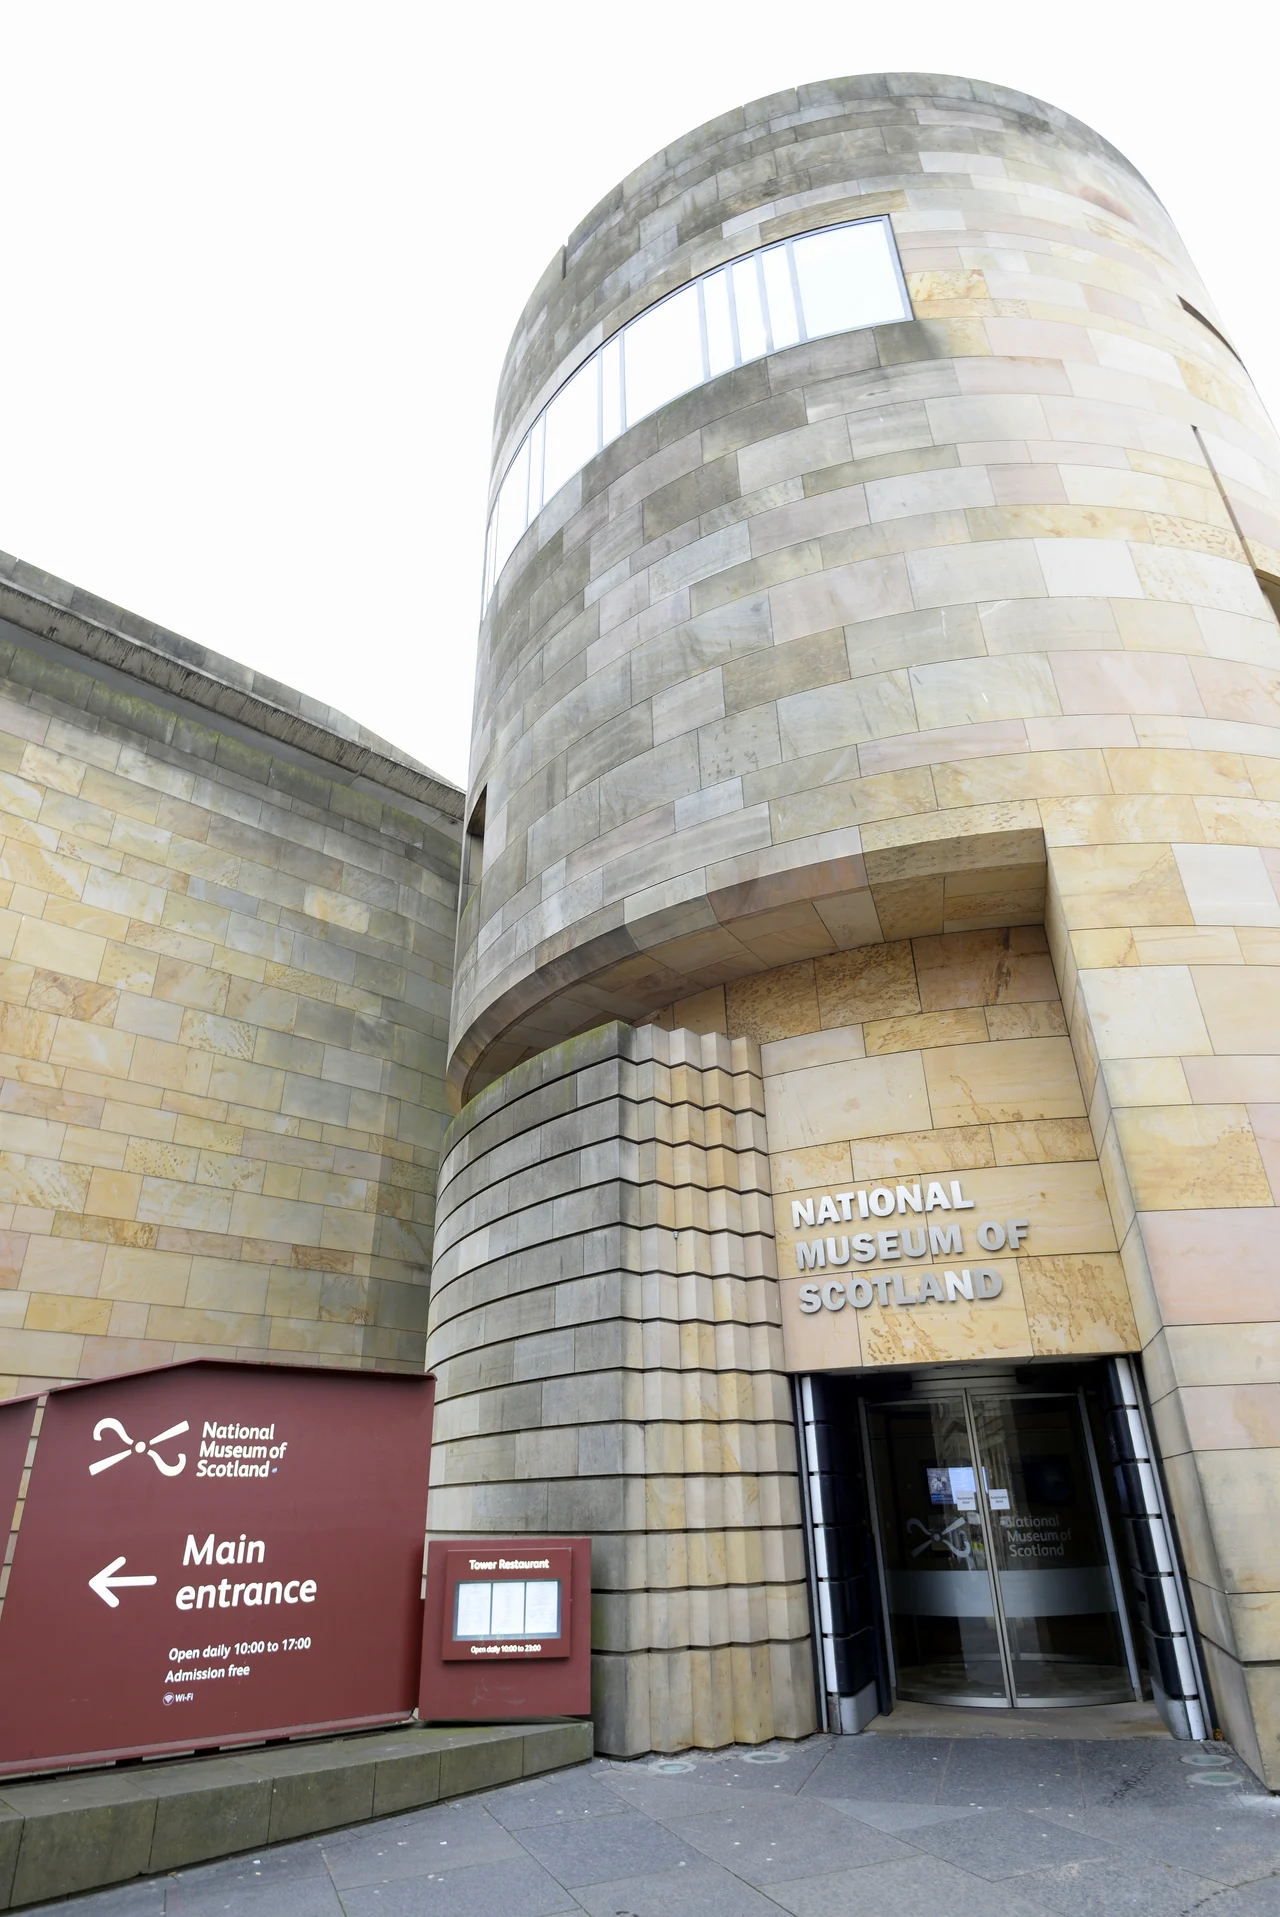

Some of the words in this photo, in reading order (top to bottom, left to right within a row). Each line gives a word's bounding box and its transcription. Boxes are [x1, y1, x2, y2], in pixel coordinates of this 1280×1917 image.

[791, 1180, 975, 1228] NATIONAL
[796, 1224, 964, 1270] MUSEUM
[976, 1219, 1029, 1251] OF
[799, 1267, 1003, 1314] SCOTLAND
[202, 1421, 275, 1440] National
[199, 1440, 268, 1459] Museum
[269, 1442, 288, 1459] of
[196, 1460, 270, 1478] Scotland
[1006, 1514, 1060, 1528] National
[1007, 1530, 1059, 1542] Museum
[1060, 1527, 1073, 1541] of
[183, 1533, 266, 1566] Main
[1009, 1543, 1065, 1557] Scotland
[469, 1559, 497, 1570] Tower
[499, 1559, 550, 1570] Restaurant
[175, 1578, 318, 1611] entrance
[168, 1647, 200, 1663] Open
[202, 1644, 231, 1659] daily
[234, 1640, 265, 1655] 10:00
[267, 1641, 279, 1652] to
[282, 1636, 312, 1651] 17:00
[470, 1645, 486, 1655] Open
[486, 1645, 501, 1654] daily
[501, 1644, 517, 1653] 10:00
[164, 1666, 225, 1683] Admission
[228, 1664, 250, 1677] free
[175, 1692, 194, 1702] Wi-Fi
